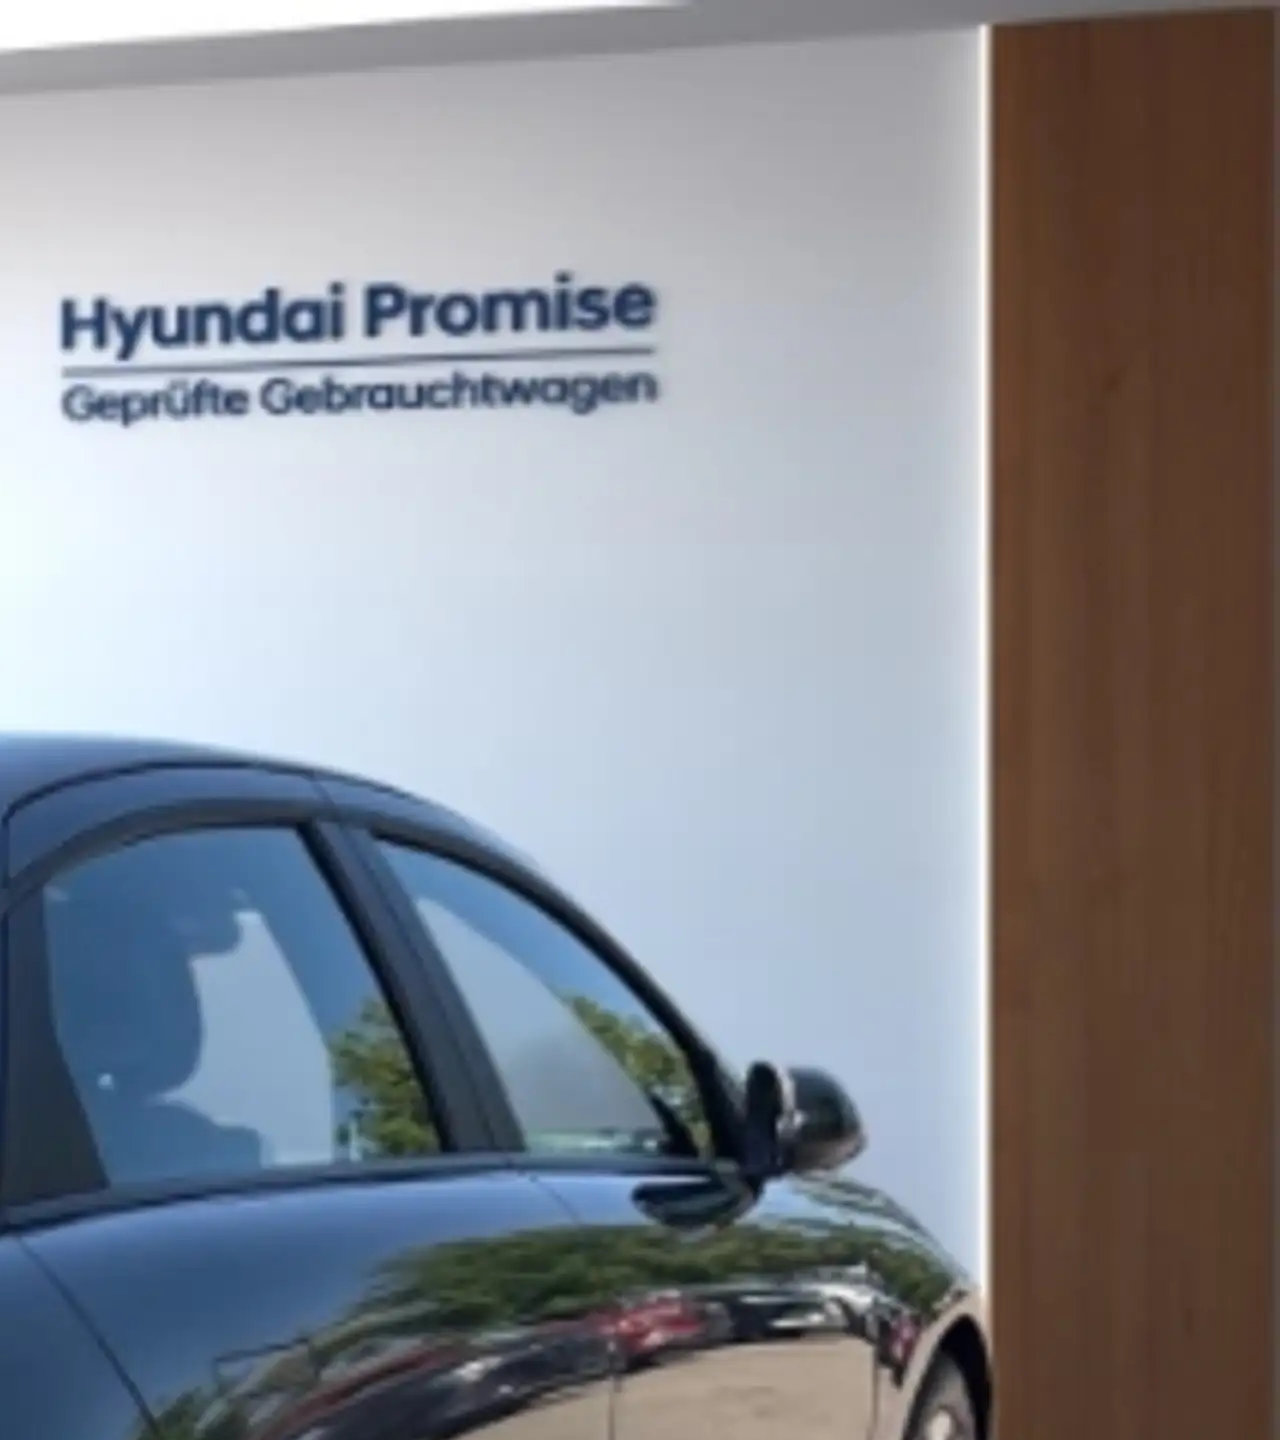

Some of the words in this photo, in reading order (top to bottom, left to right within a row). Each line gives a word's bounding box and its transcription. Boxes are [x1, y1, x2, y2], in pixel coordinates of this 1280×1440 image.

[61, 282, 342, 360] Hyundai
[362, 272, 655, 339] Promise
[61, 379, 250, 426] Geprüfte
[259, 369, 658, 415] Gebrauchtwagen
